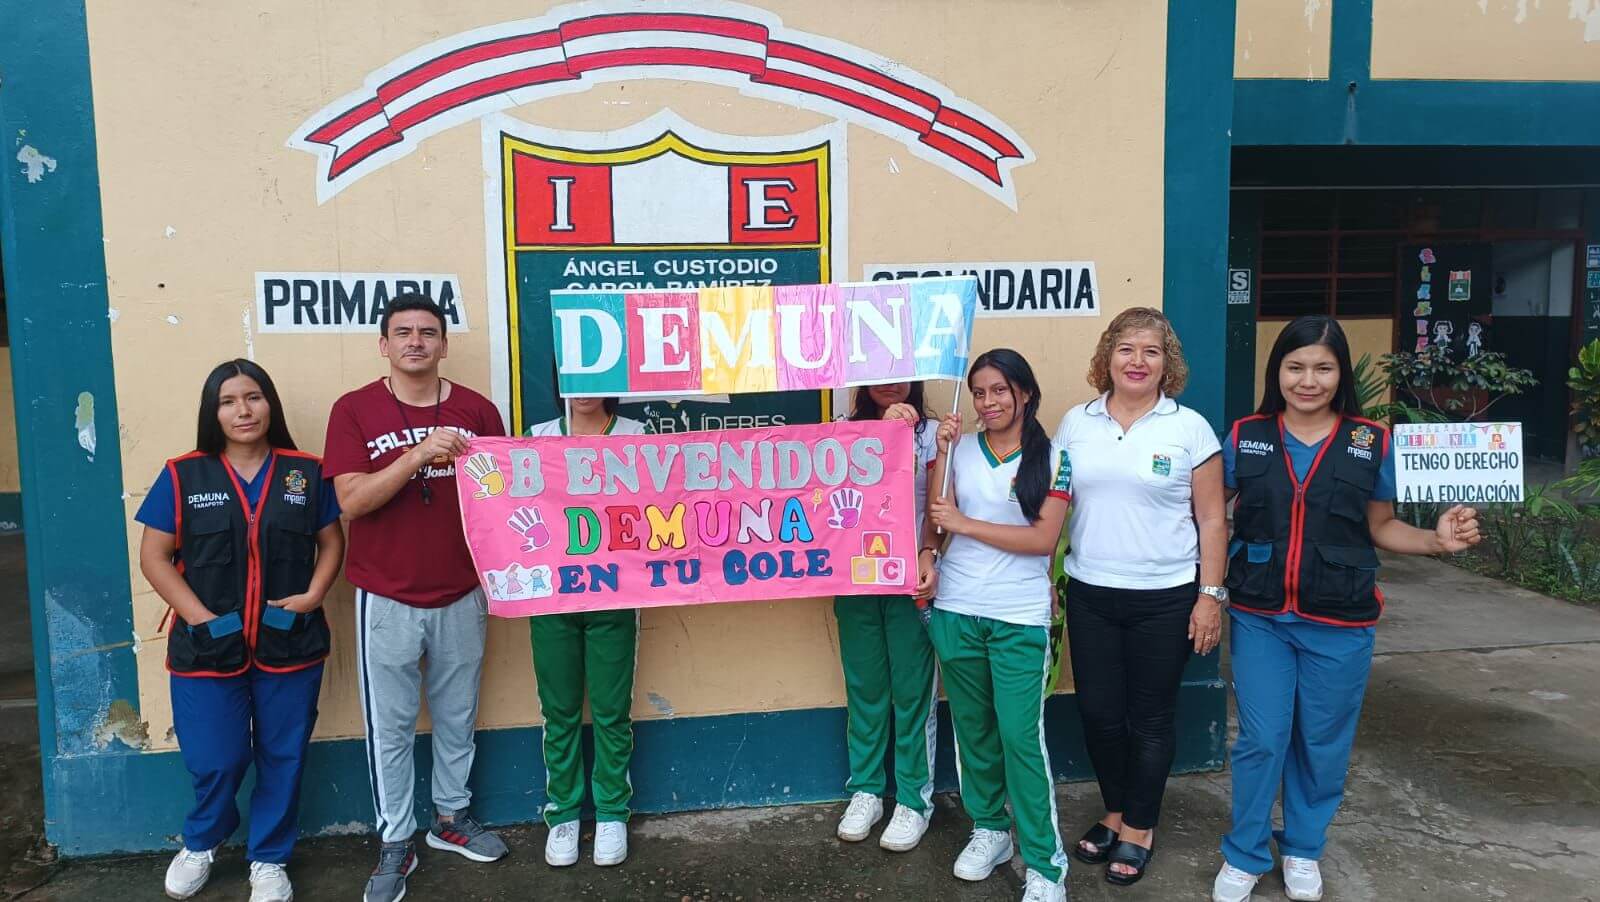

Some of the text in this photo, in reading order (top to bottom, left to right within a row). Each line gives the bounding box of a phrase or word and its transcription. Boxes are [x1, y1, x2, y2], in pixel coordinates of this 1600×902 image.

[549, 177, 797, 231] I E
[563, 257, 778, 277] ÁNGEL CUSTODIO
[1232, 271, 1248, 290] S
[263, 279, 460, 325] PRIMAA
[555, 292, 969, 376] DEMUNA
[1239, 440, 1274, 453] DEMUNA
[1402, 451, 1519, 471] TENGO DERECHO
[188, 492, 230, 505] DEMUNA
[1404, 480, 1520, 502] A LA EDUCACIÓN
[564, 496, 815, 556] DEMUNA
[869, 535, 888, 555] A
[558, 563, 619, 594] EN
[646, 558, 701, 588] TU
[883, 561, 899, 580] C
